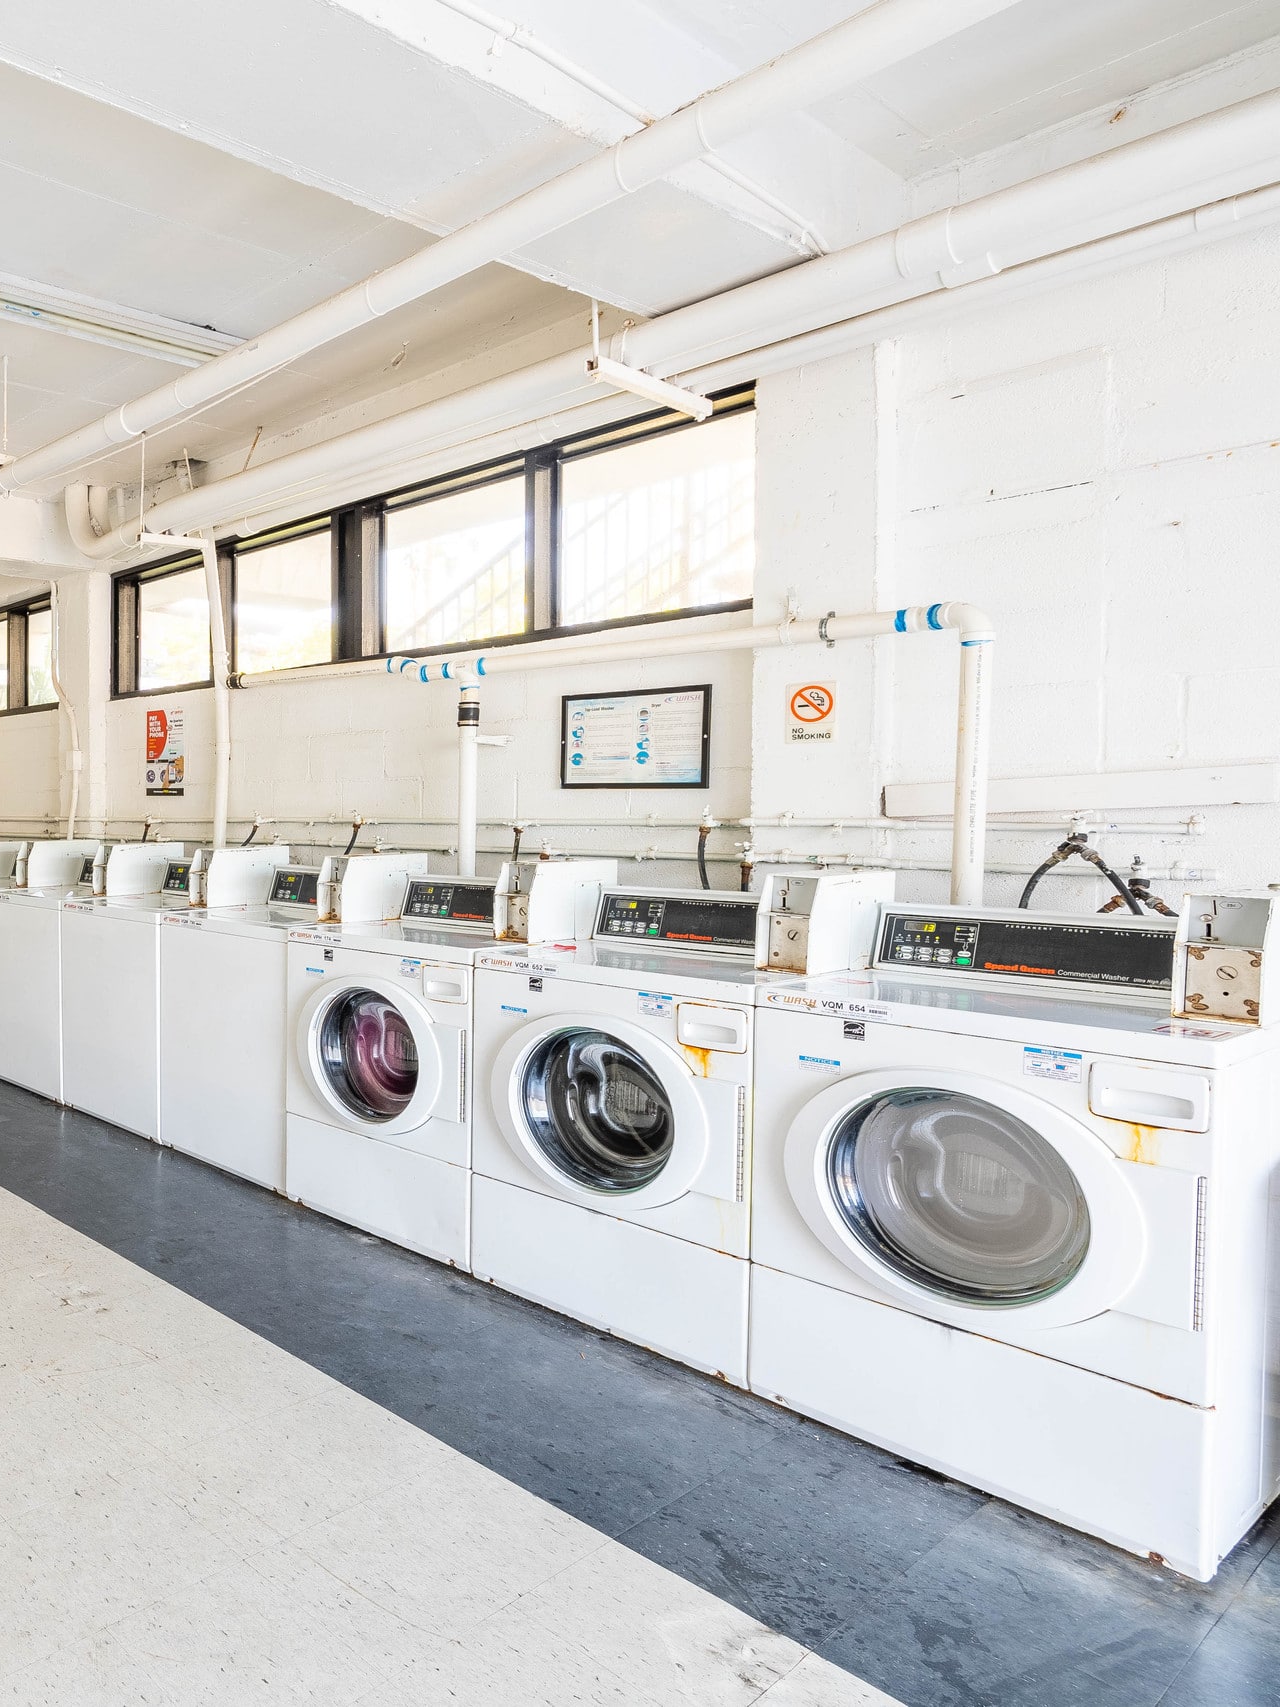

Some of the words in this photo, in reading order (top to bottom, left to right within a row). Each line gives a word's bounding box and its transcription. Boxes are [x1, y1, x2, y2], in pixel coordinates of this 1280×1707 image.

[791, 732, 831, 741] SMOKING
[923, 924, 936, 932] 13
[689, 934, 712, 942] Queen
[713, 936, 740, 944] Commercial
[491, 958, 513, 967] WASH
[514, 961, 529, 969] VQM
[984, 961, 1019, 973] Speed
[1019, 964, 1056, 975] Queen
[1057, 969, 1100, 980] Commercial
[1101, 972, 1130, 982] Washer
[783, 995, 817, 1009] WASH
[821, 1000, 844, 1010] VQM
[848, 1004, 866, 1013] 654
[804, 1056, 835, 1065] NOTICE
